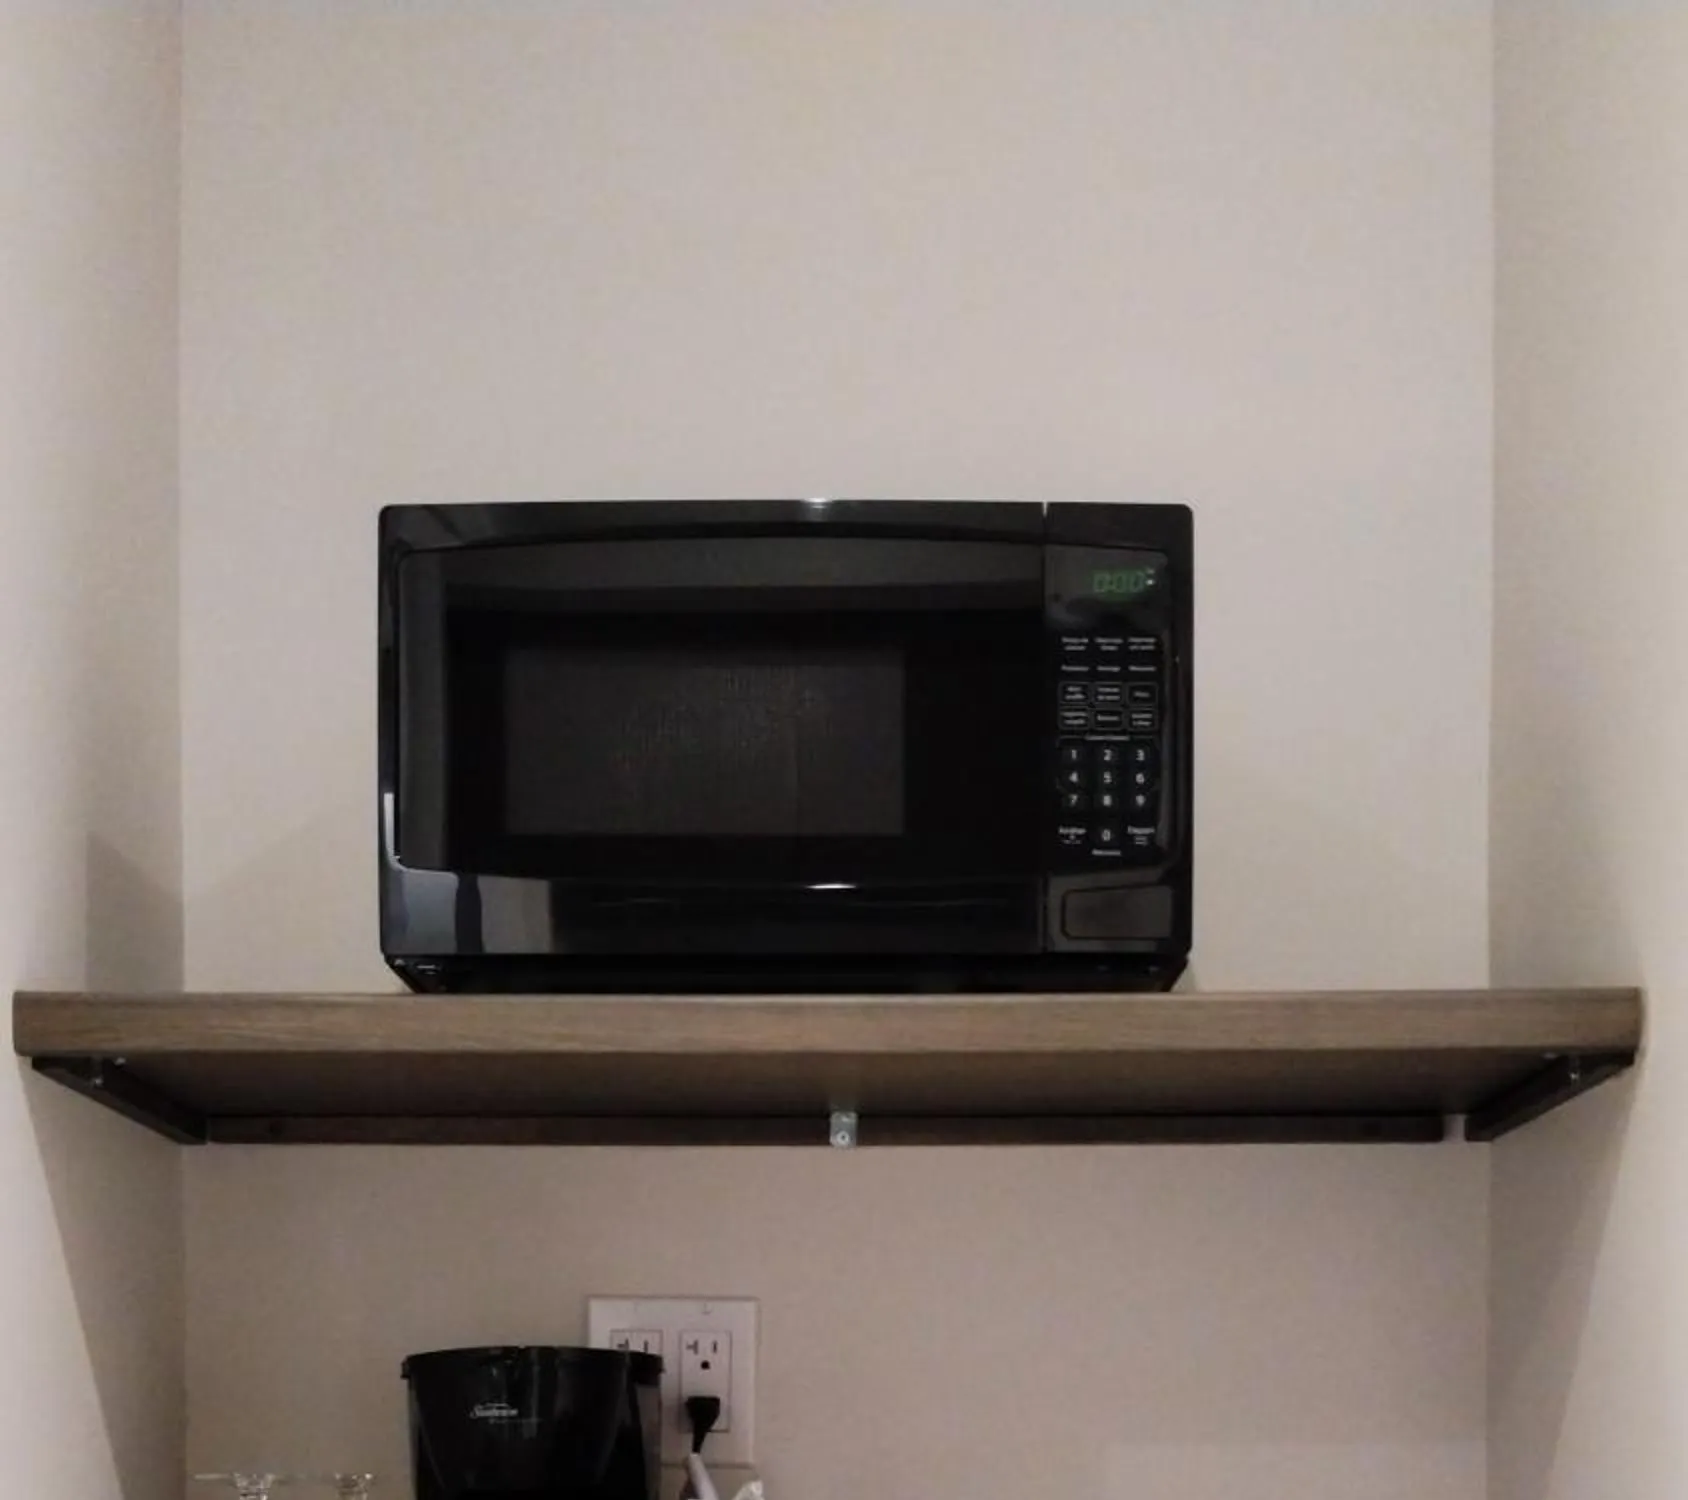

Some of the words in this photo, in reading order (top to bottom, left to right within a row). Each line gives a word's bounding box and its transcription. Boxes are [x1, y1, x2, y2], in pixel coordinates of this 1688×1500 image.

[1071, 749, 1077, 760] 1
[1103, 749, 1112, 761] 2
[1136, 749, 1145, 761] 3
[1069, 772, 1078, 783] 4
[1103, 771, 1112, 784] 5
[1135, 773, 1145, 784] 6
[1070, 794, 1078, 805] 7
